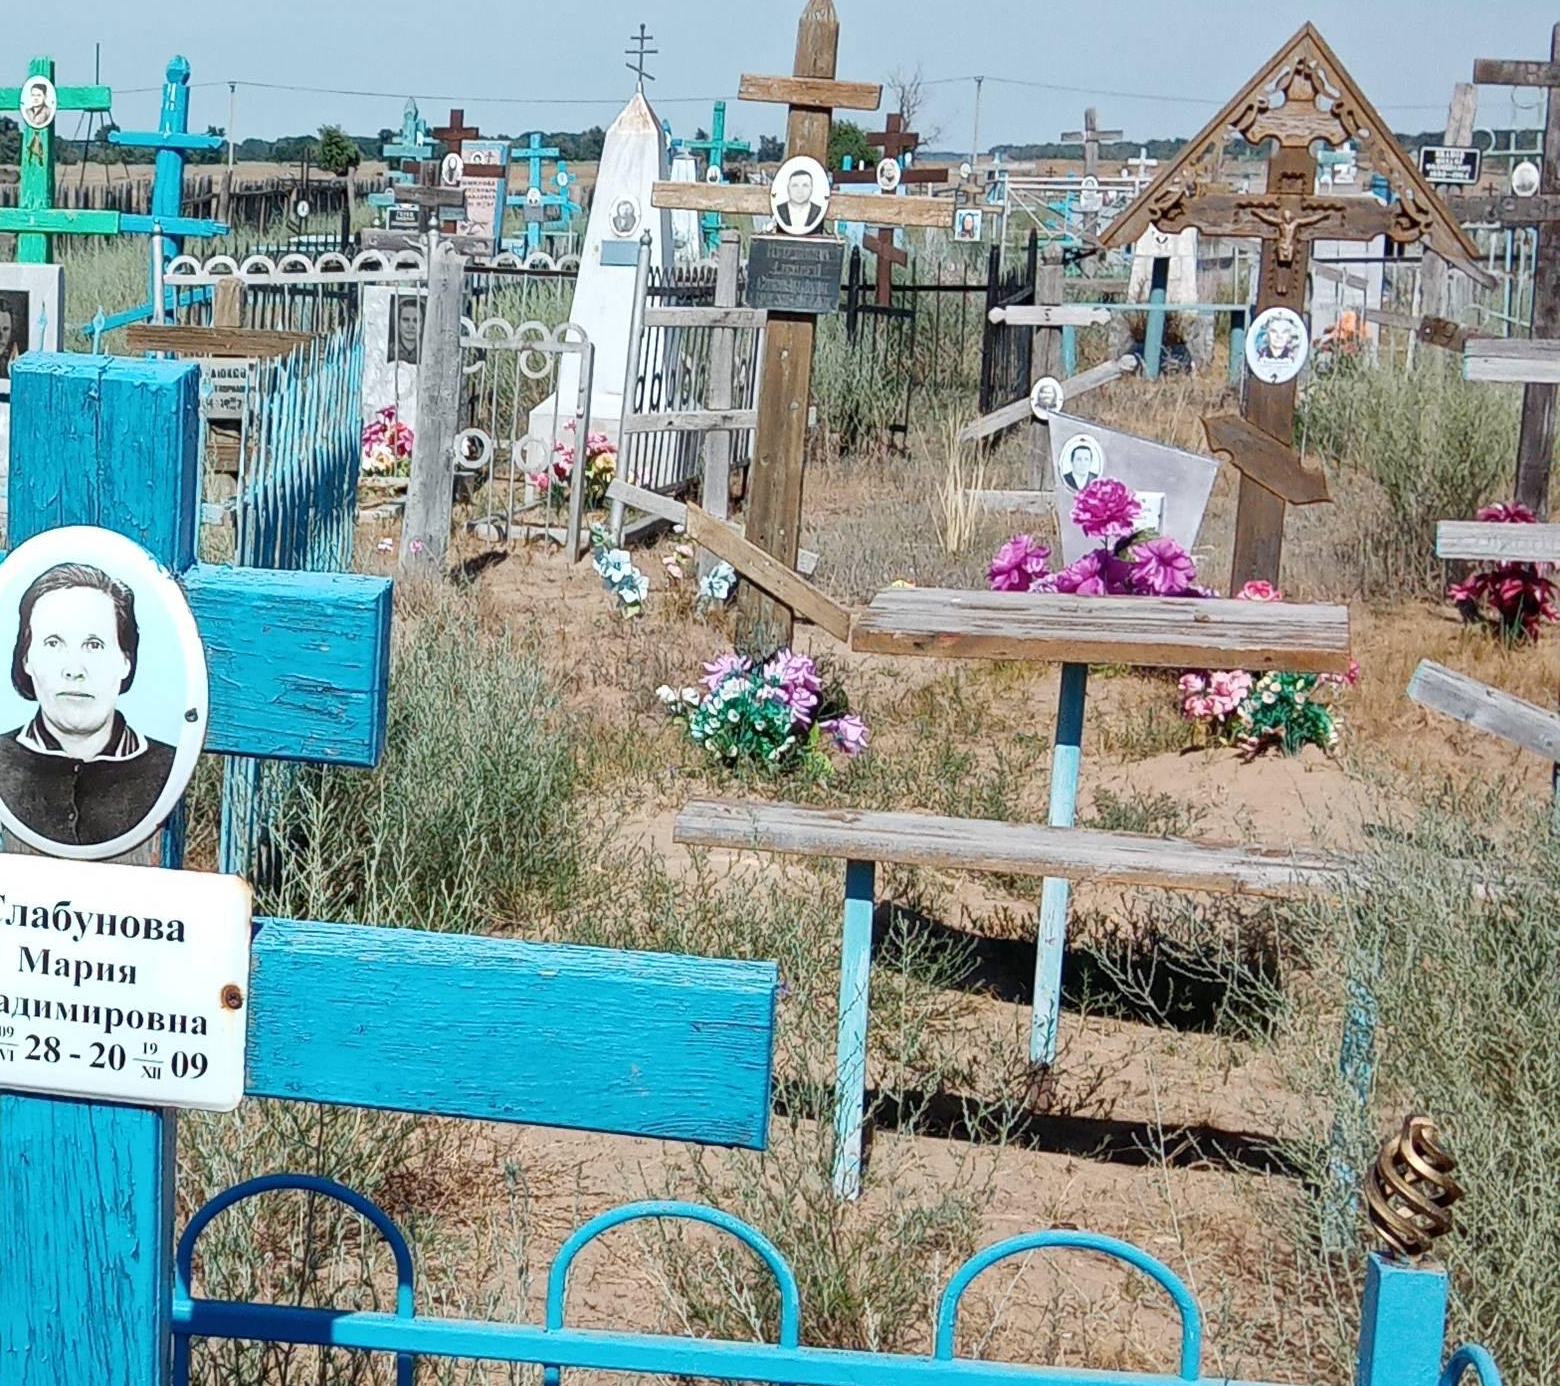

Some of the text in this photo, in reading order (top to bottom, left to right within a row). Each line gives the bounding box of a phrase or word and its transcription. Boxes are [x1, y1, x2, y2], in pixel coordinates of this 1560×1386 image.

[18, 945, 137, 987] Мария
[24, 1033, 61, 1064] 28
[89, 1041, 126, 1072] 20
[170, 1050, 209, 1080] 09
